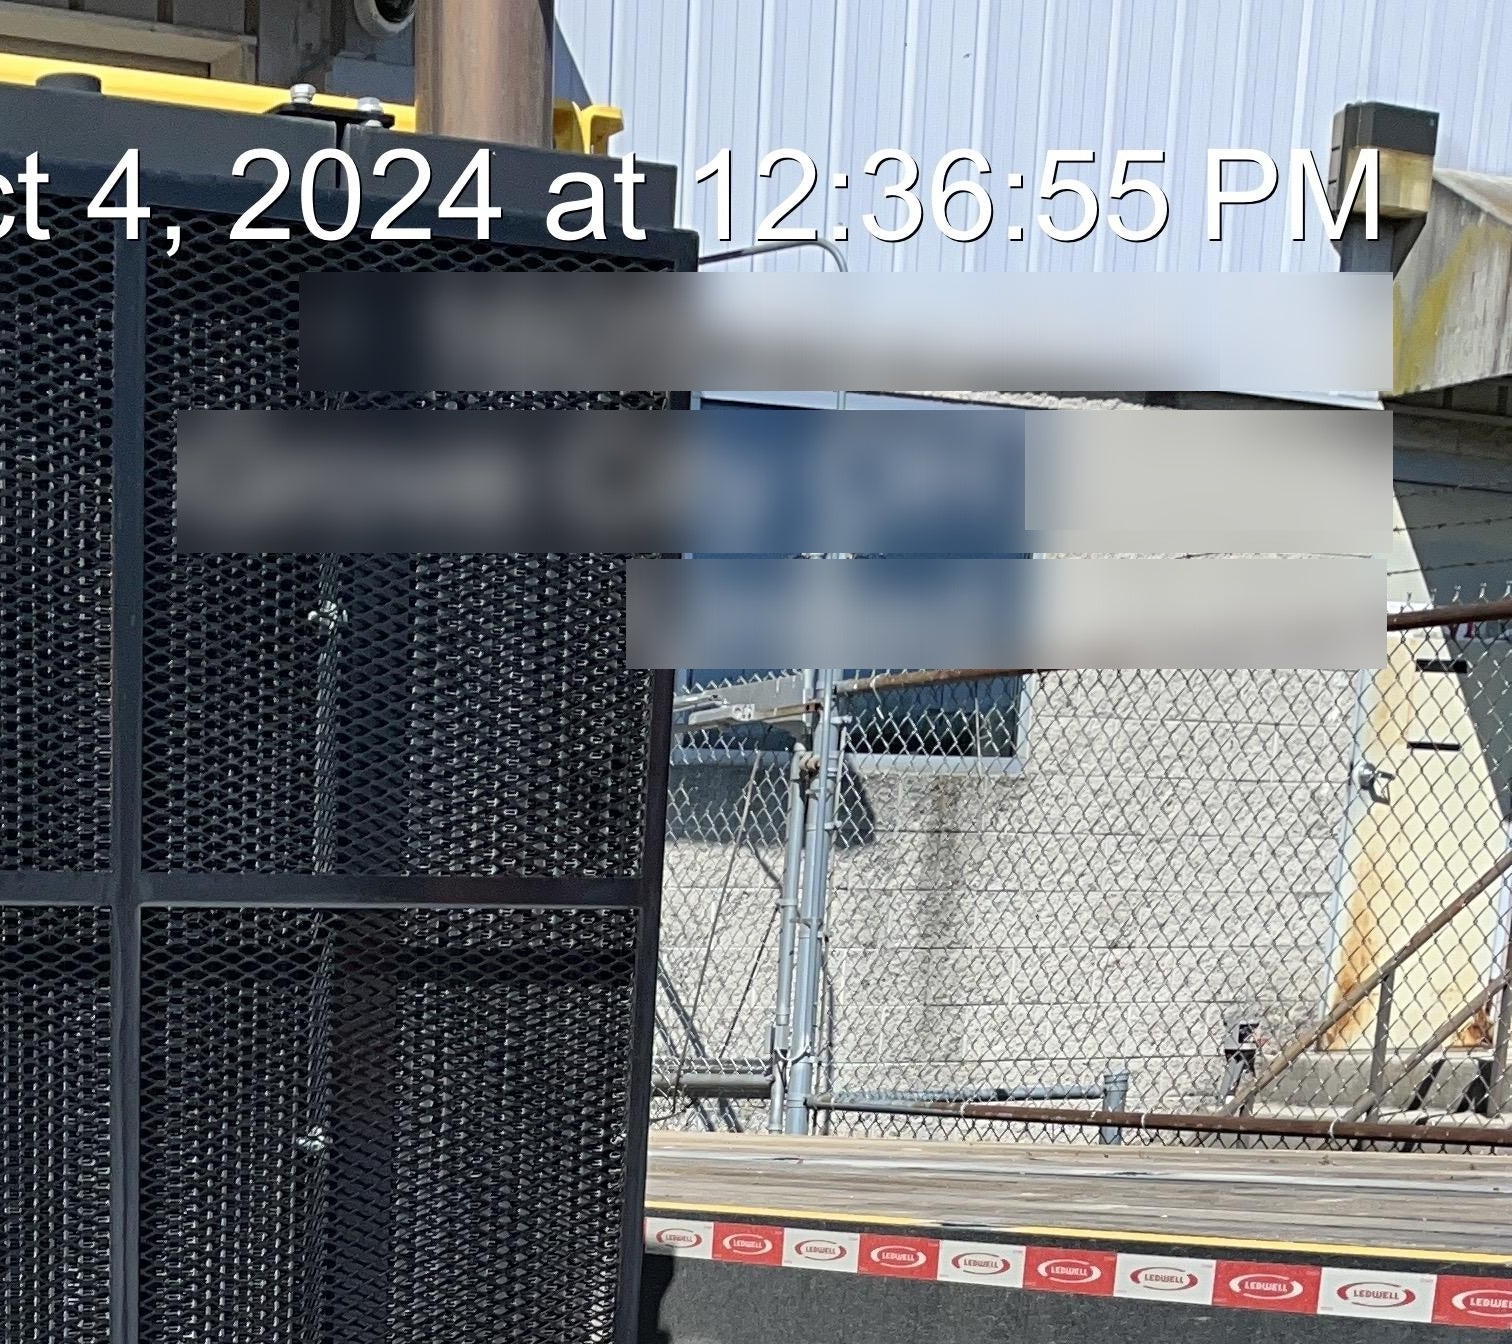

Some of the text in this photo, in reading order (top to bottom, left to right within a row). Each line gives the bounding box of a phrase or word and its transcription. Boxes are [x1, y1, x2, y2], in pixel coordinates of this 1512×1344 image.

[805, 1245, 837, 1256] LEDWELL
[881, 1251, 915, 1262] LEDWELL
[963, 1259, 999, 1270] LEDWELL
[1050, 1265, 1088, 1276] LEDWELL
[1144, 1273, 1185, 1285] LEDWELL
[1244, 1280, 1288, 1292] LEDWELL
[1353, 1289, 1400, 1301] LEDWELL
